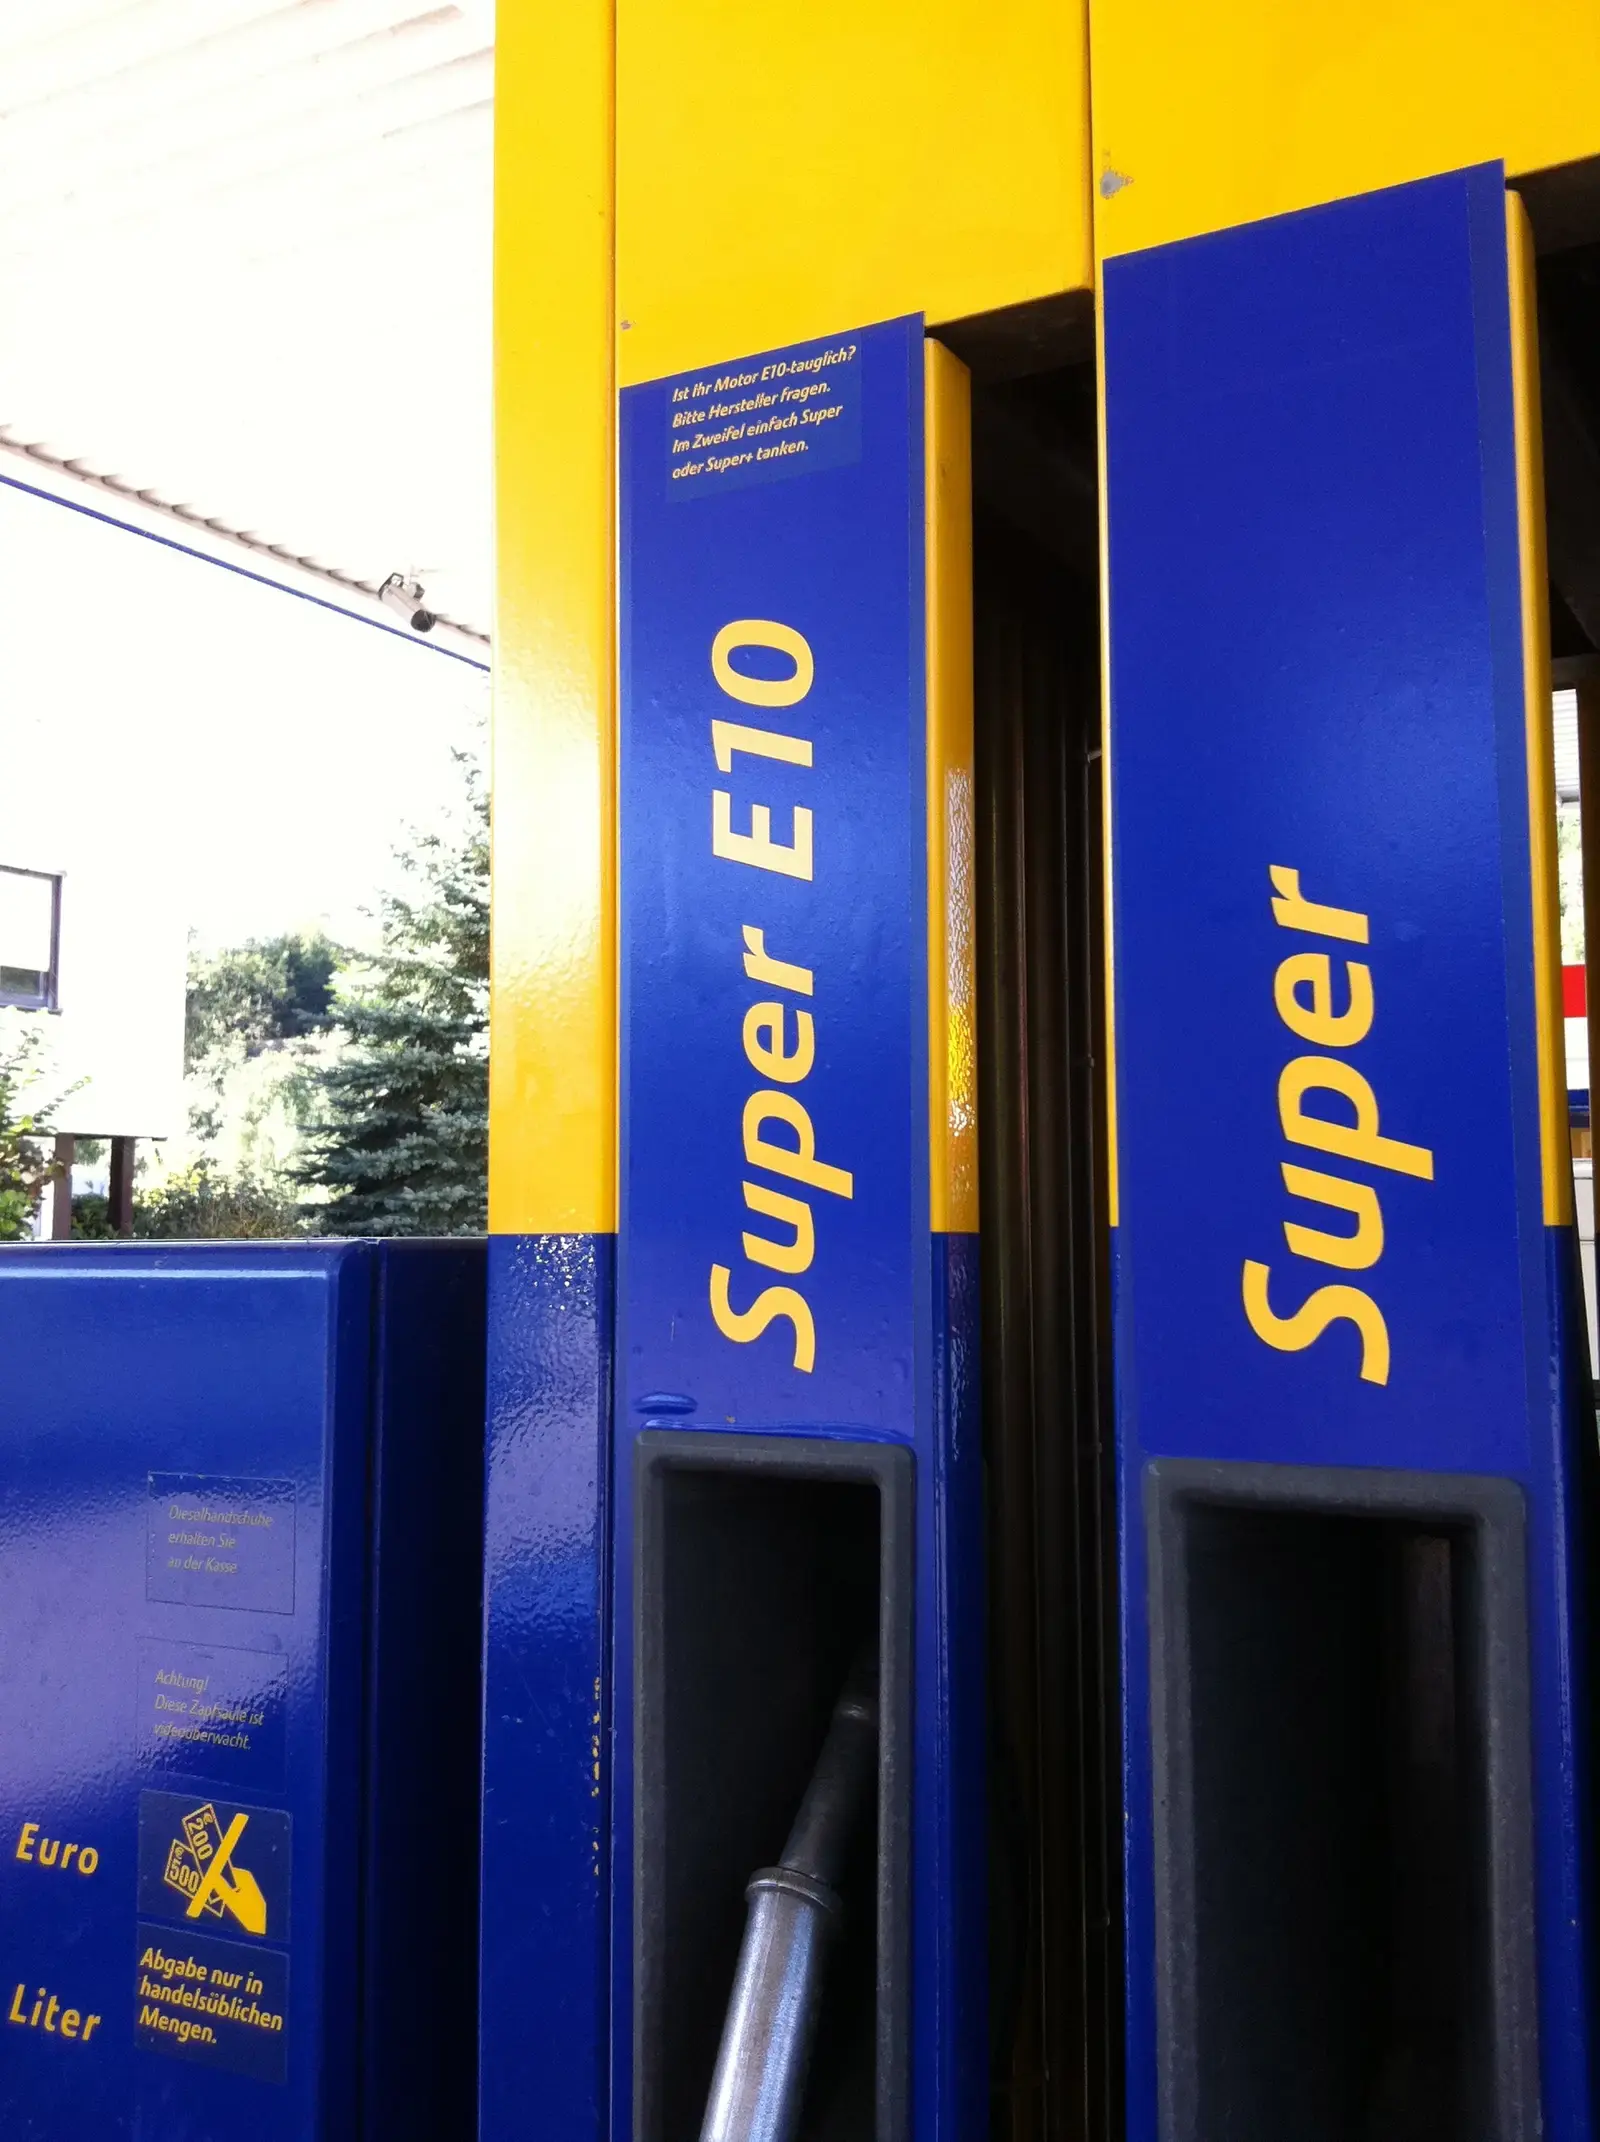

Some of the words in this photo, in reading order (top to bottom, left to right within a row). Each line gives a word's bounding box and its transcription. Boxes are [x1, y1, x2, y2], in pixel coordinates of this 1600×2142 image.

[672, 387, 689, 402] Ist
[692, 382, 712, 398] Ihr
[714, 371, 758, 392] Motor
[761, 345, 856, 381] E10-tauglich?
[672, 411, 705, 428] Bitte
[708, 393, 778, 419] Hersteller
[780, 381, 831, 403] fragen.
[672, 439, 690, 453] Im
[692, 424, 745, 450] Zweifel
[747, 413, 798, 436] einfach
[800, 405, 843, 427] Super
[672, 460, 704, 479] oder
[705, 452, 753, 473] Super+
[756, 440, 809, 461] tanken.
[711, 619, 814, 881] E10
[1242, 865, 1433, 1385] Super
[710, 925, 853, 1373] Super
[168, 1504, 275, 1528] Dieselhandschuhe
[167, 1556, 182, 1568] an
[184, 1554, 203, 1570] der
[168, 1531, 216, 1548] erhalten
[218, 1533, 237, 1549] Sie
[154, 1668, 209, 1694] Achtung!
[154, 1694, 188, 1715] Diese
[249, 1709, 264, 1726] ist
[154, 1721, 252, 1751] videoüberwacht.
[15, 1822, 99, 1875] Euro
[139, 1947, 208, 1982] Abgabe
[211, 1965, 243, 1989] nur
[245, 1971, 264, 1995] in
[8, 1983, 101, 2041] Liter
[139, 1975, 283, 2032] handelsüblichen
[139, 2005, 217, 2044] Mengen.
